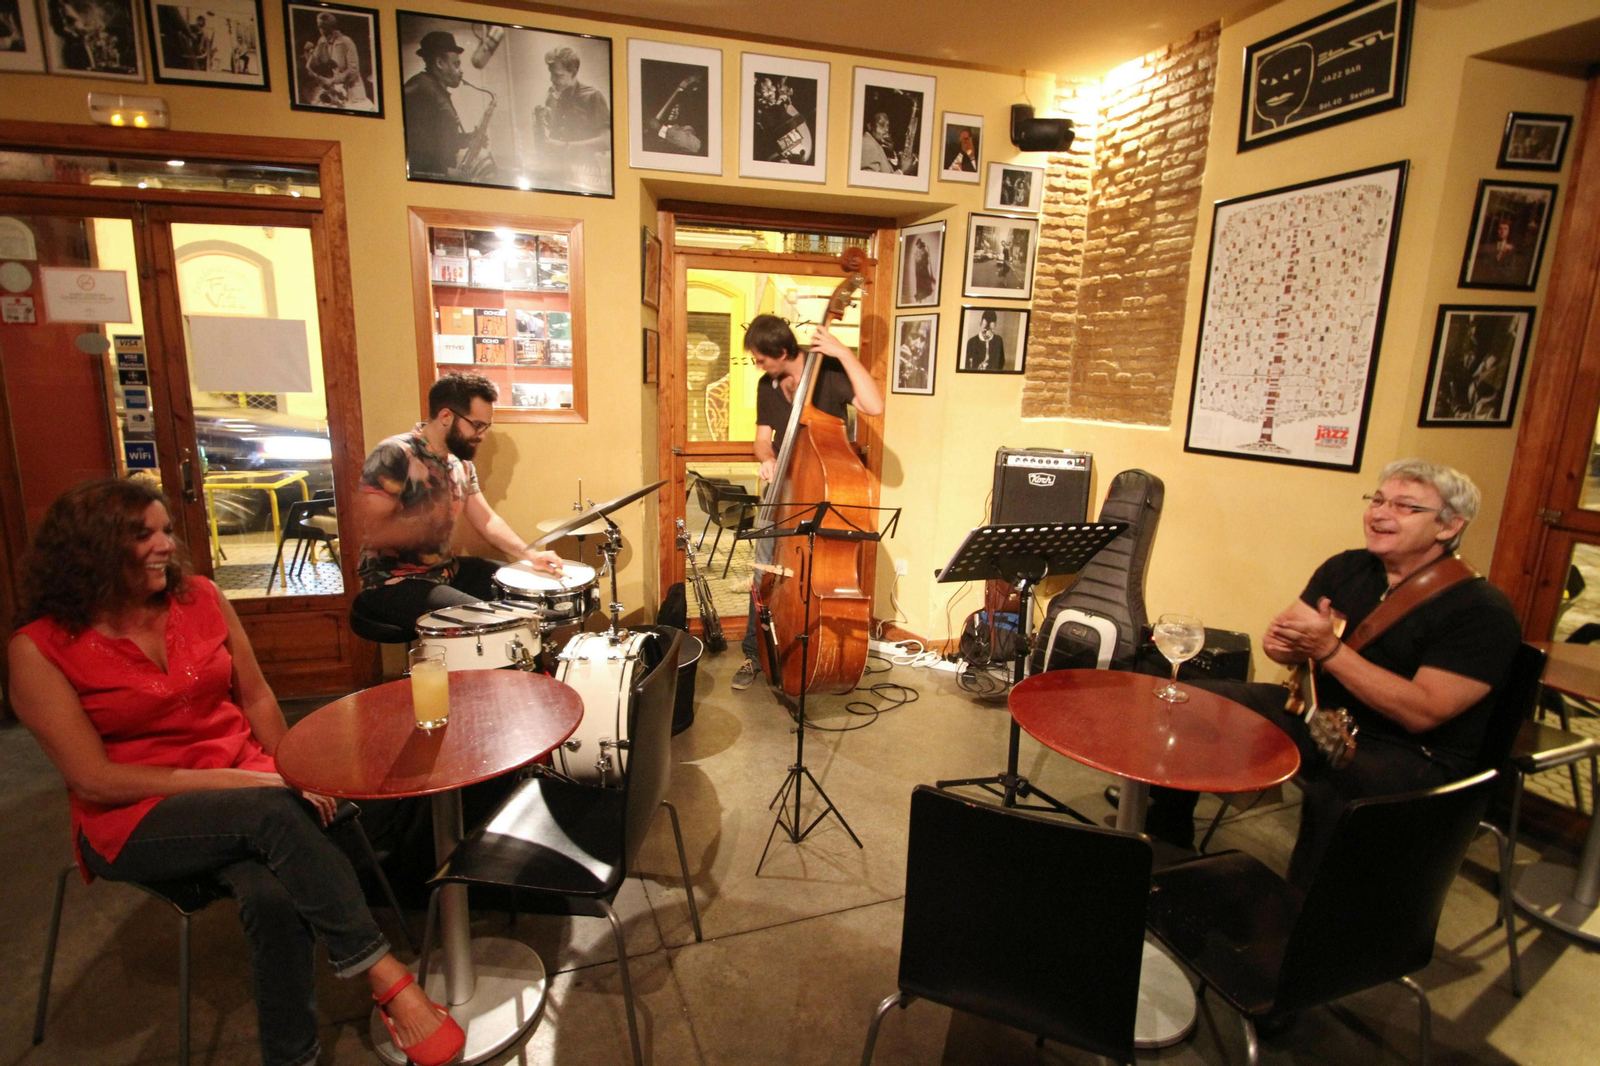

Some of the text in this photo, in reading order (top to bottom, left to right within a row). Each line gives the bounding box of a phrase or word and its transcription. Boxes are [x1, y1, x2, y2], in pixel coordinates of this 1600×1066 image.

[1322, 64, 1361, 84] JAZZ BAR
[1349, 87, 1375, 100] Sevilla
[1314, 425, 1349, 441] jazz
[1030, 474, 1053, 484] Koch
